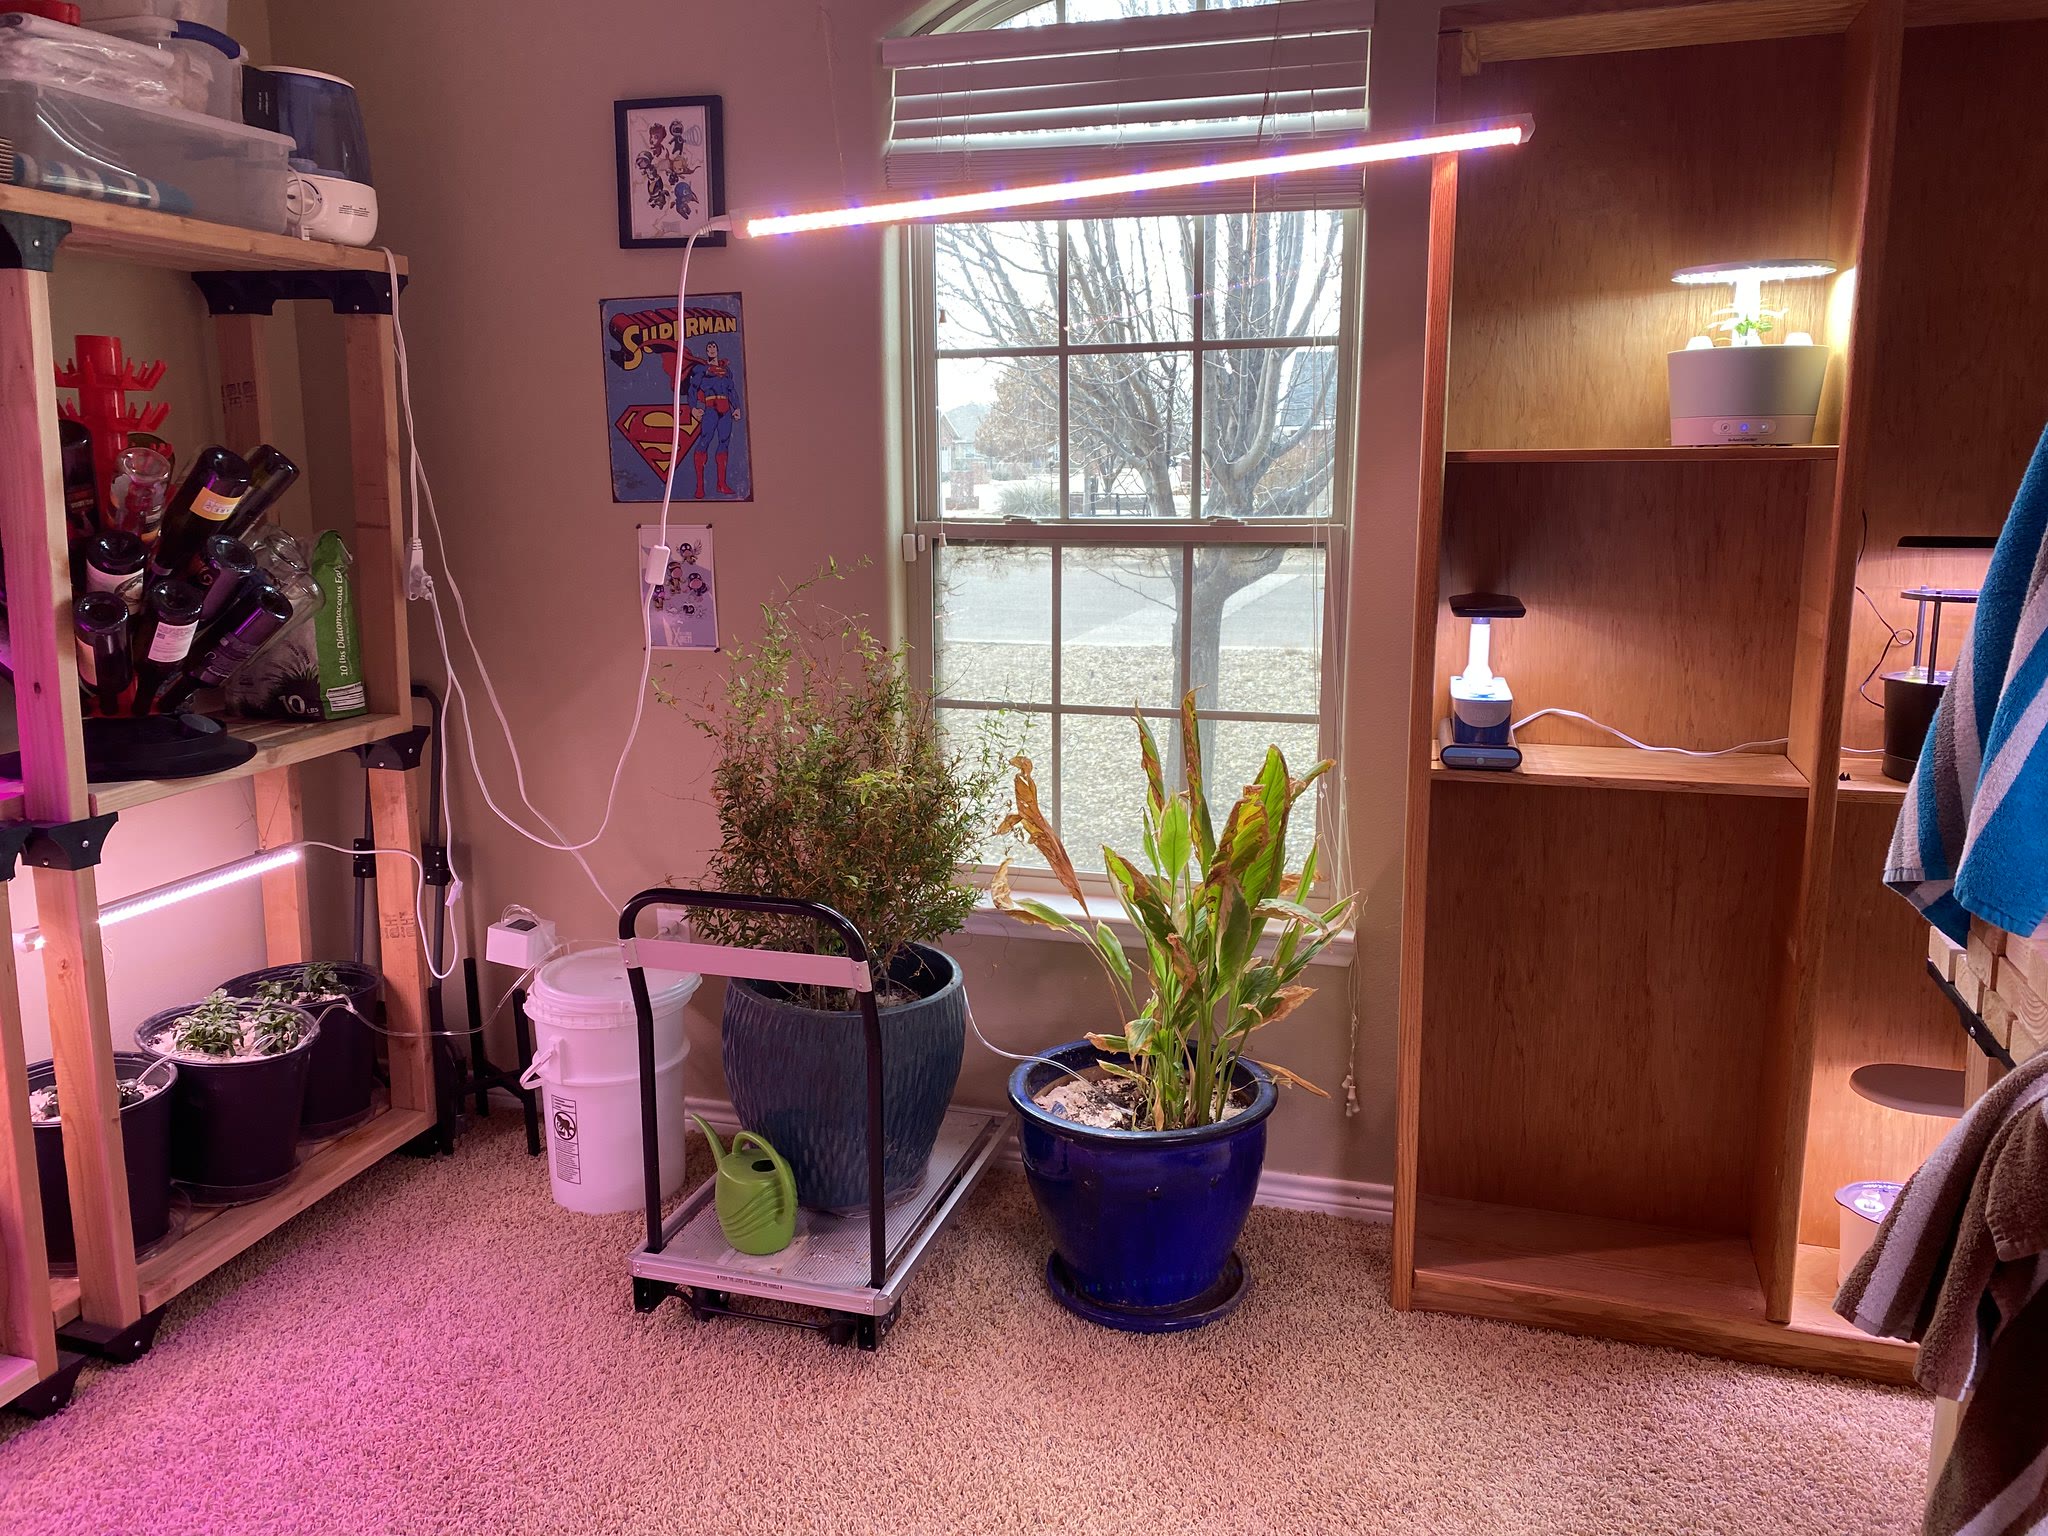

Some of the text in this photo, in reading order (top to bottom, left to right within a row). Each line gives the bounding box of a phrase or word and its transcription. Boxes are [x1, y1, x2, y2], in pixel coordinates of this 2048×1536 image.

[336, 585, 345, 649] Diatomaceous
[340, 666, 348, 677] 10
[278, 694, 306, 714] 10
